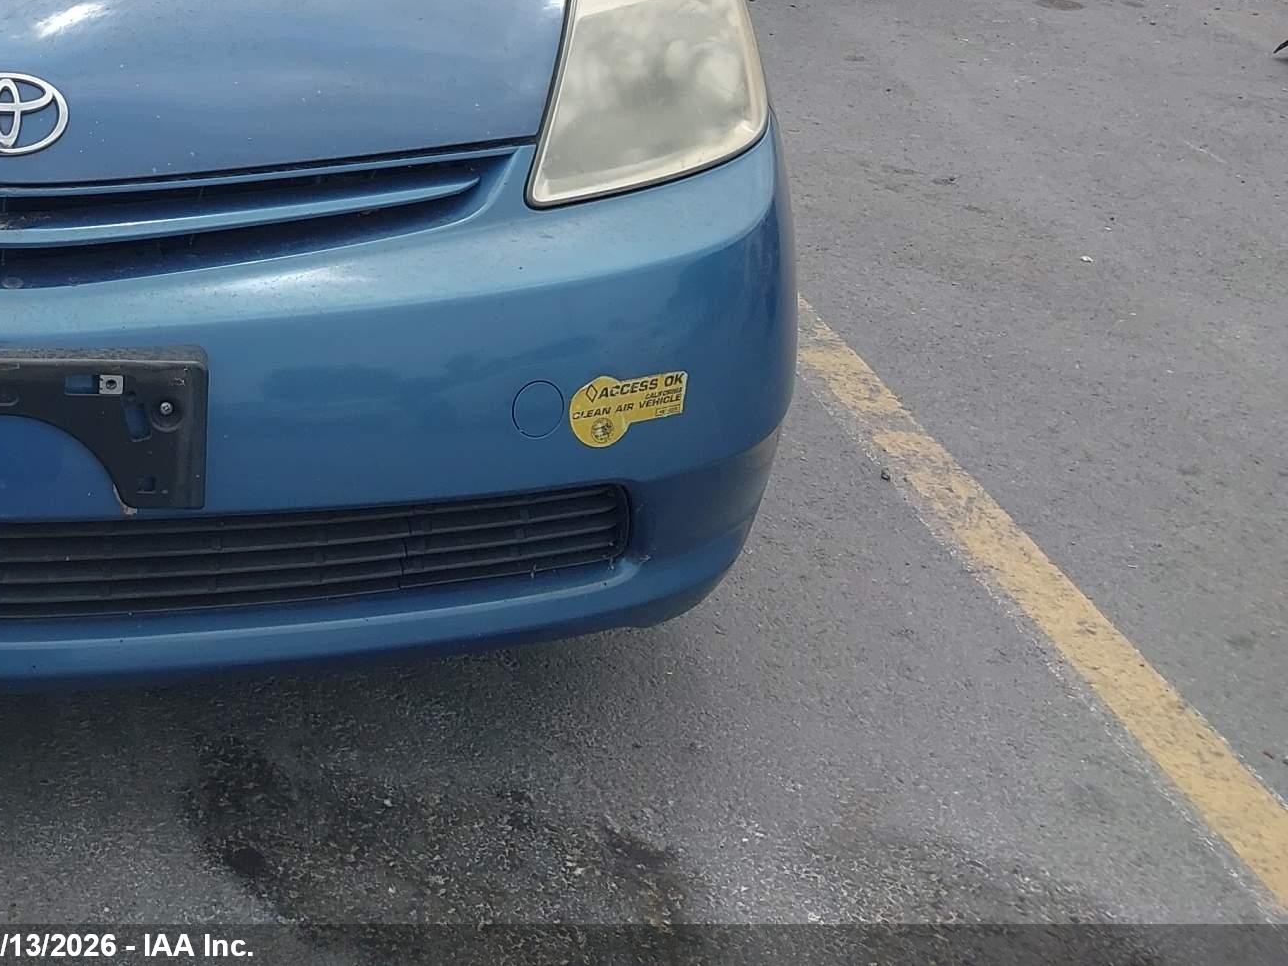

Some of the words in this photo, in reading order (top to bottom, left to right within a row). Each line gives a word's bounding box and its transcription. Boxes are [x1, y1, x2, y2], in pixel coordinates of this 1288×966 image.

[598, 378, 658, 400] ACCESS
[664, 374, 684, 387] OK
[644, 386, 683, 400] CALIFORNIA
[572, 406, 612, 420] CLEAN
[615, 402, 634, 413] AIR
[639, 394, 681, 409] VEHICLE
